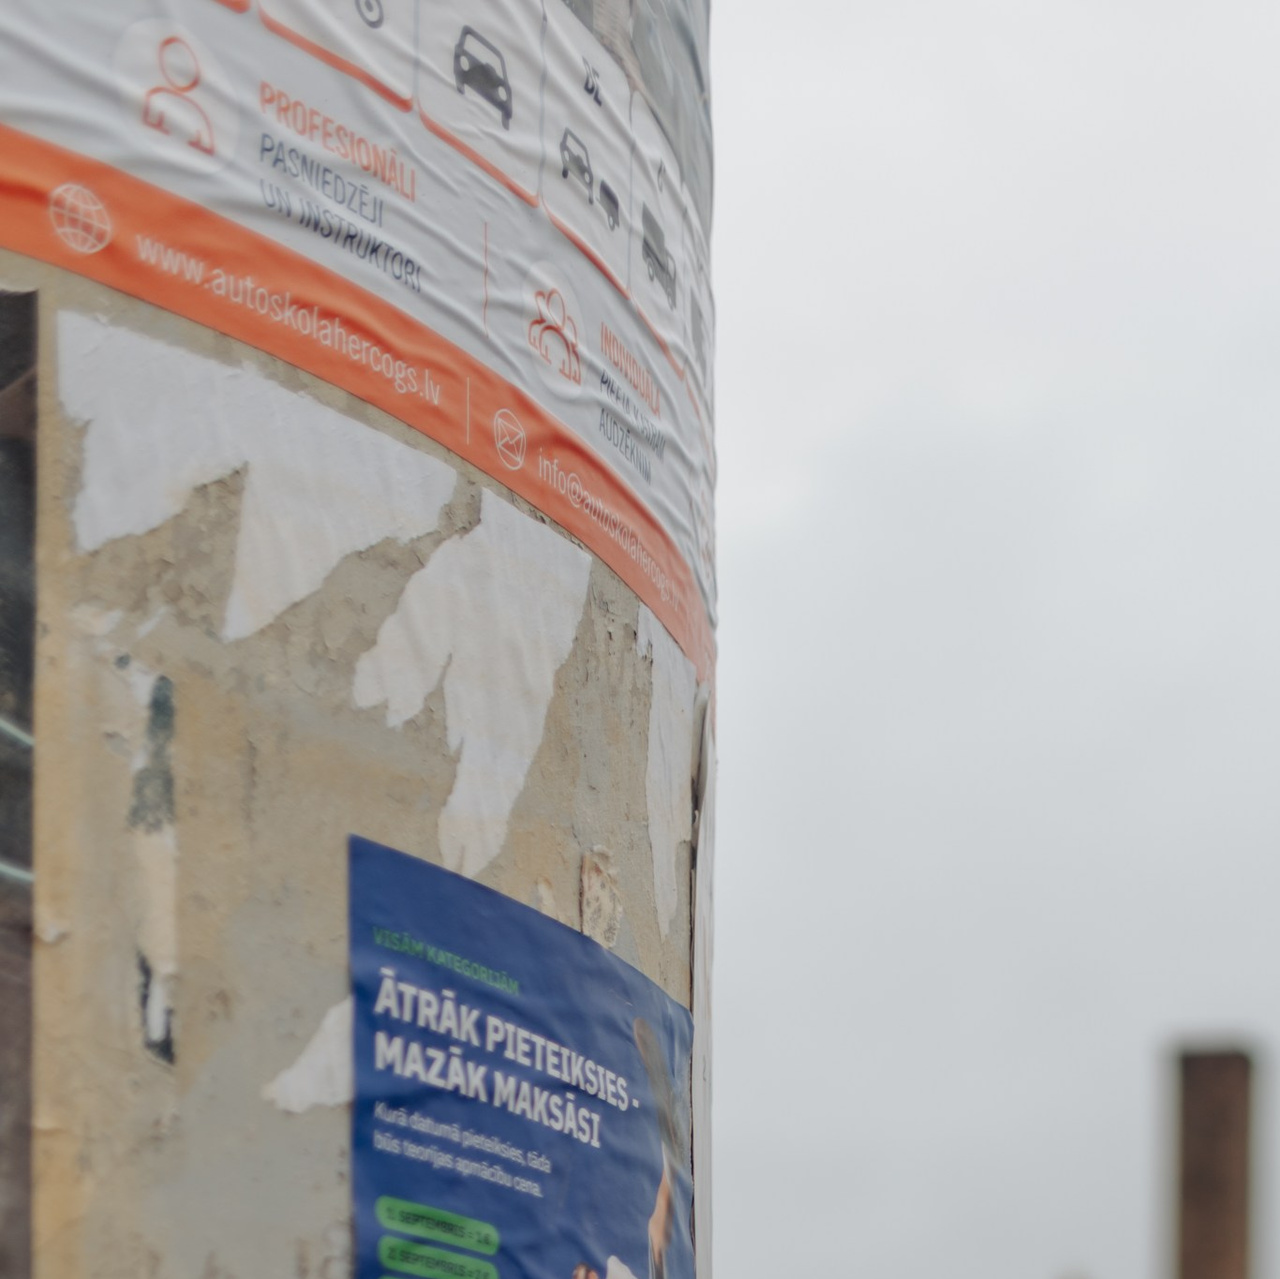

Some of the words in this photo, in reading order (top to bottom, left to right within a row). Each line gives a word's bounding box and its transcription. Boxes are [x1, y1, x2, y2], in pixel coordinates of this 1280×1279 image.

[260, 83, 416, 202] PROFESIONĀLI
[260, 134, 383, 227] PASNIEDZĒJI
[260, 180, 291, 217] UN
[300, 201, 421, 292] INSTRUKTORI
[136, 235, 441, 406] www.autoskolahercogs.lv
[600, 409, 651, 486] AUDZĒKNIM
[373, 928, 423, 956] VISĀM
[427, 947, 520, 995] KATEGORIJĀM
[374, 968, 481, 1046] ĀTRĀK
[486, 1016, 629, 1111] PIETEIKSIES
[374, 1032, 488, 1102] MAZĀK
[493, 1071, 601, 1148] MAKSĀSI
[374, 1102, 407, 1126] Kurā
[410, 1113, 460, 1142] datumā
[526, 1150, 552, 1174] tāda
[374, 1130, 400, 1153] būs
[403, 1142, 452, 1168] teorijas
